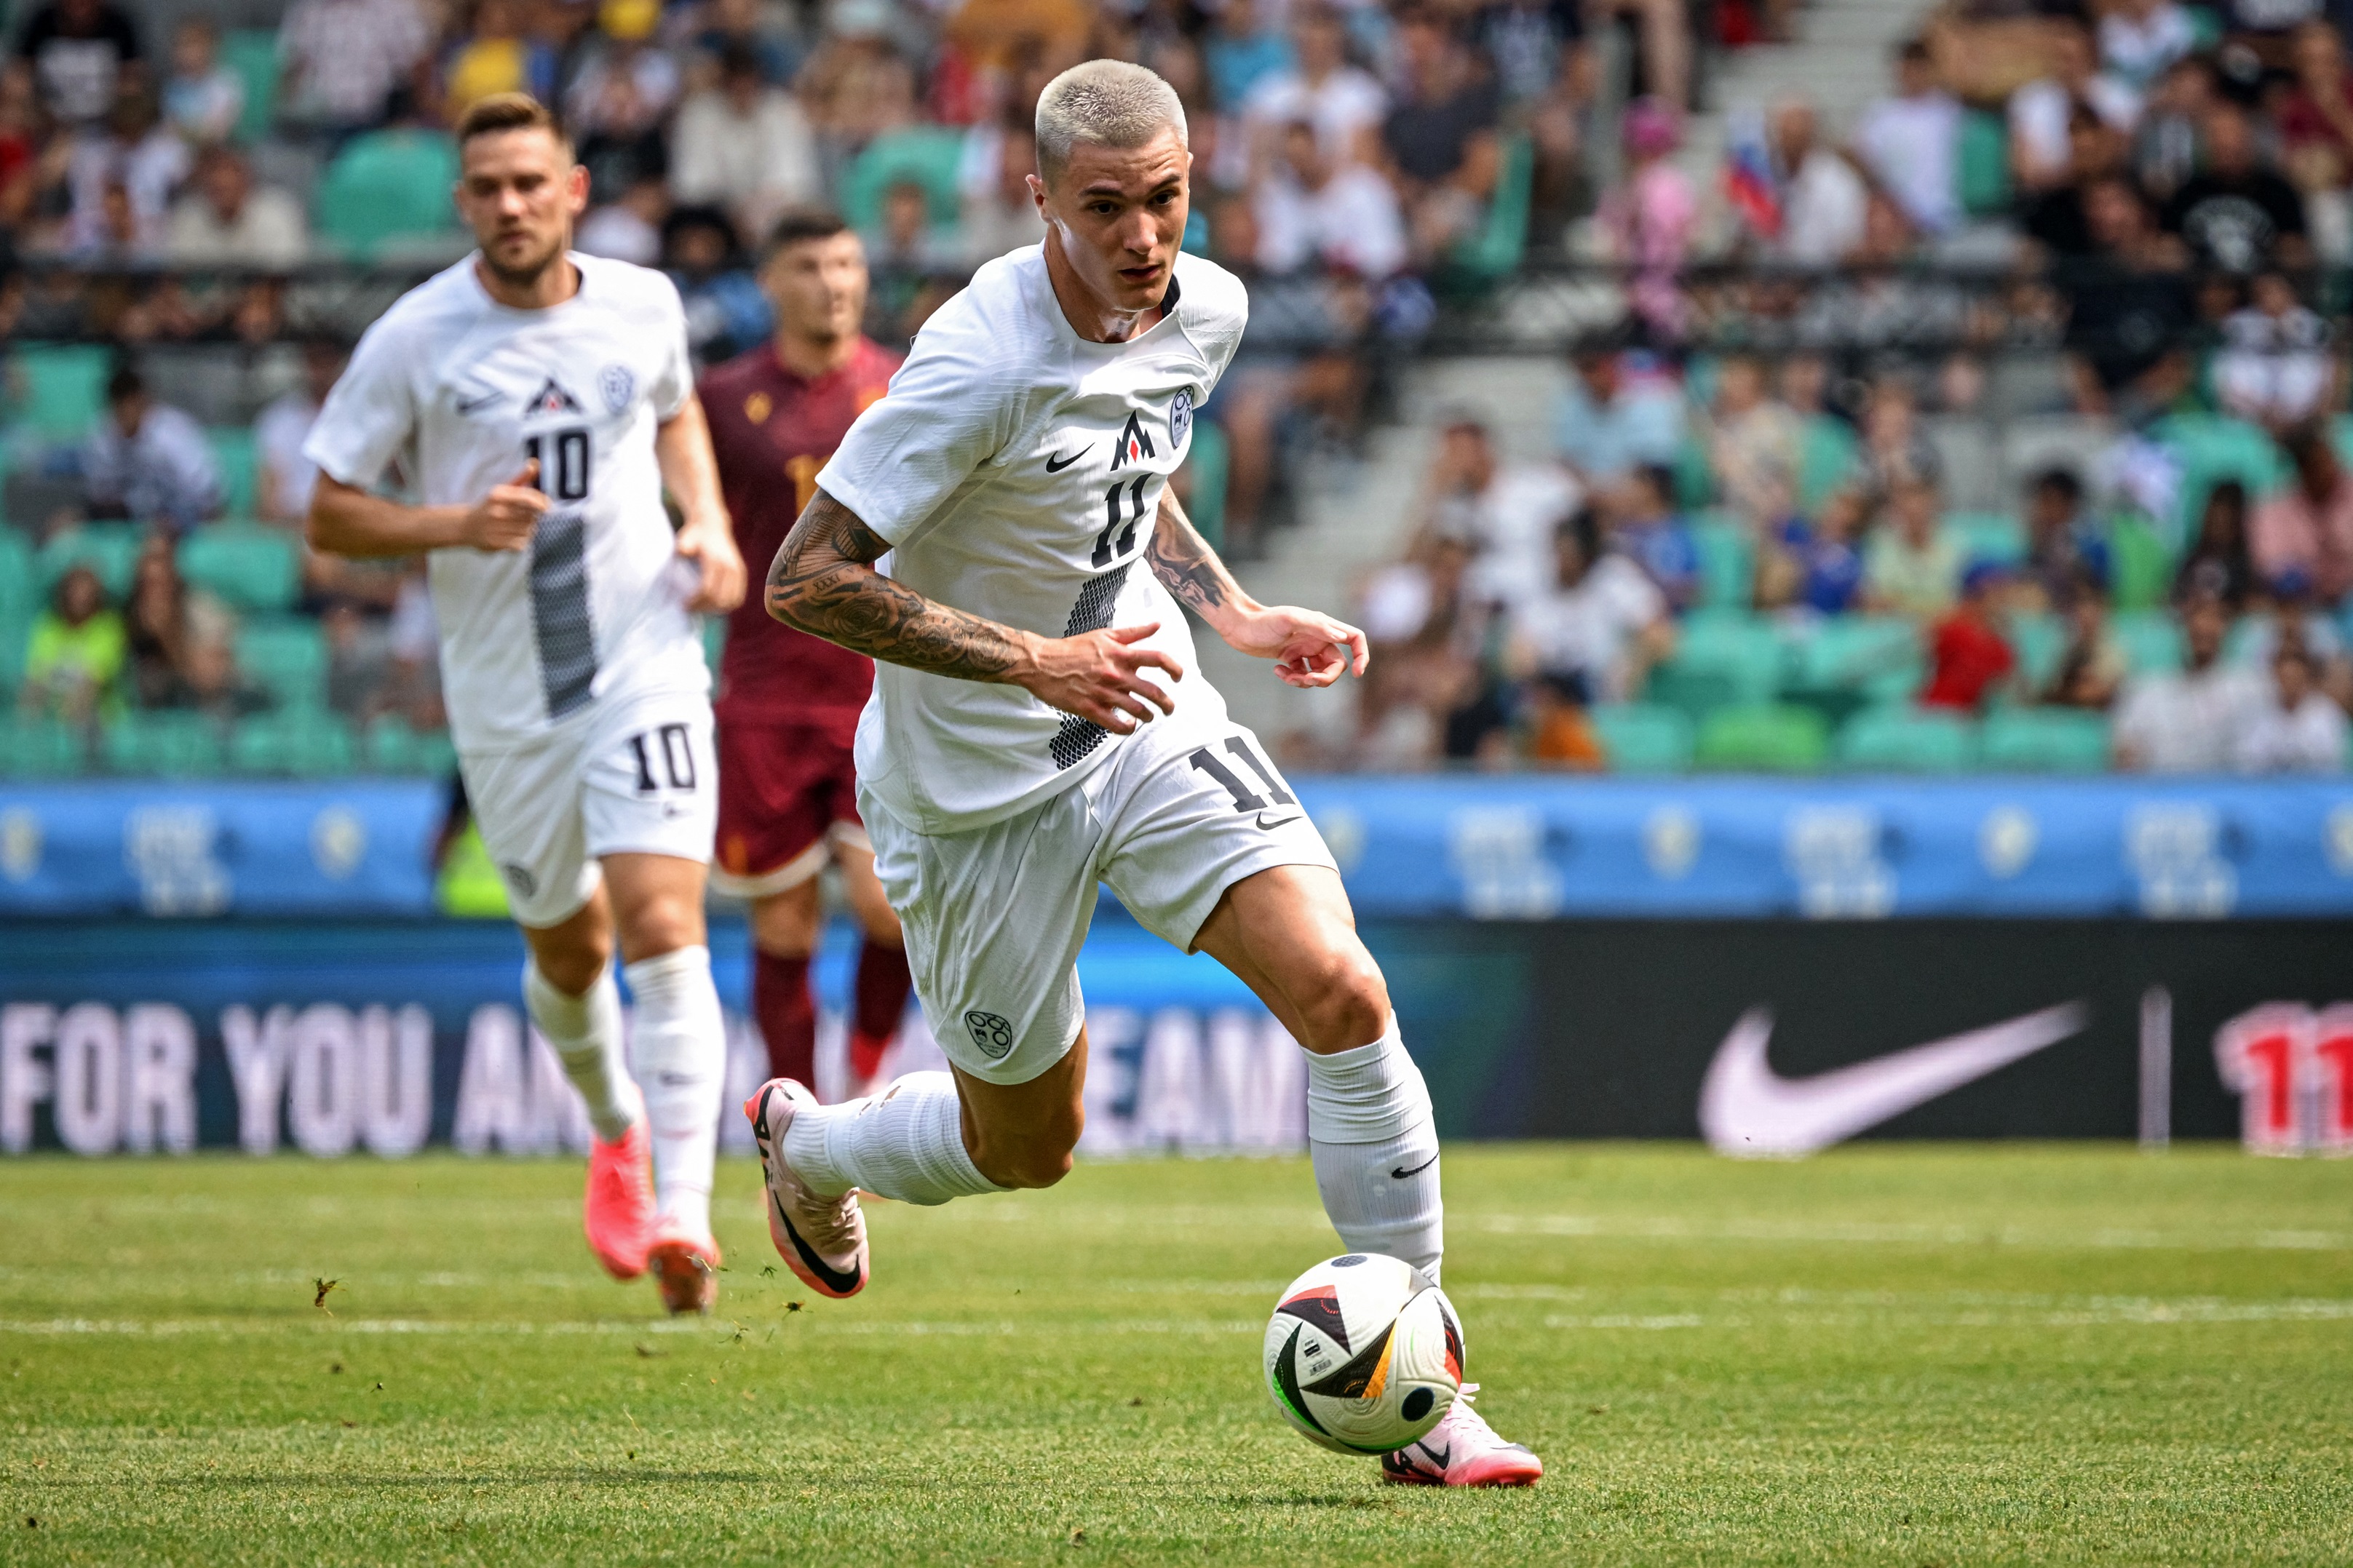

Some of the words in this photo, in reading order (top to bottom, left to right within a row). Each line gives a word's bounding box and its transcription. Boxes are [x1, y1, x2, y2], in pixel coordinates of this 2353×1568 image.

[525, 427, 588, 500] 10
[1092, 472, 1154, 569] 11
[629, 723, 697, 791] 10
[1189, 736, 1296, 813] 11
[0, 1003, 197, 1155] FOR
[221, 1003, 432, 1157] YOU
[1082, 1003, 1309, 1157] EAM
